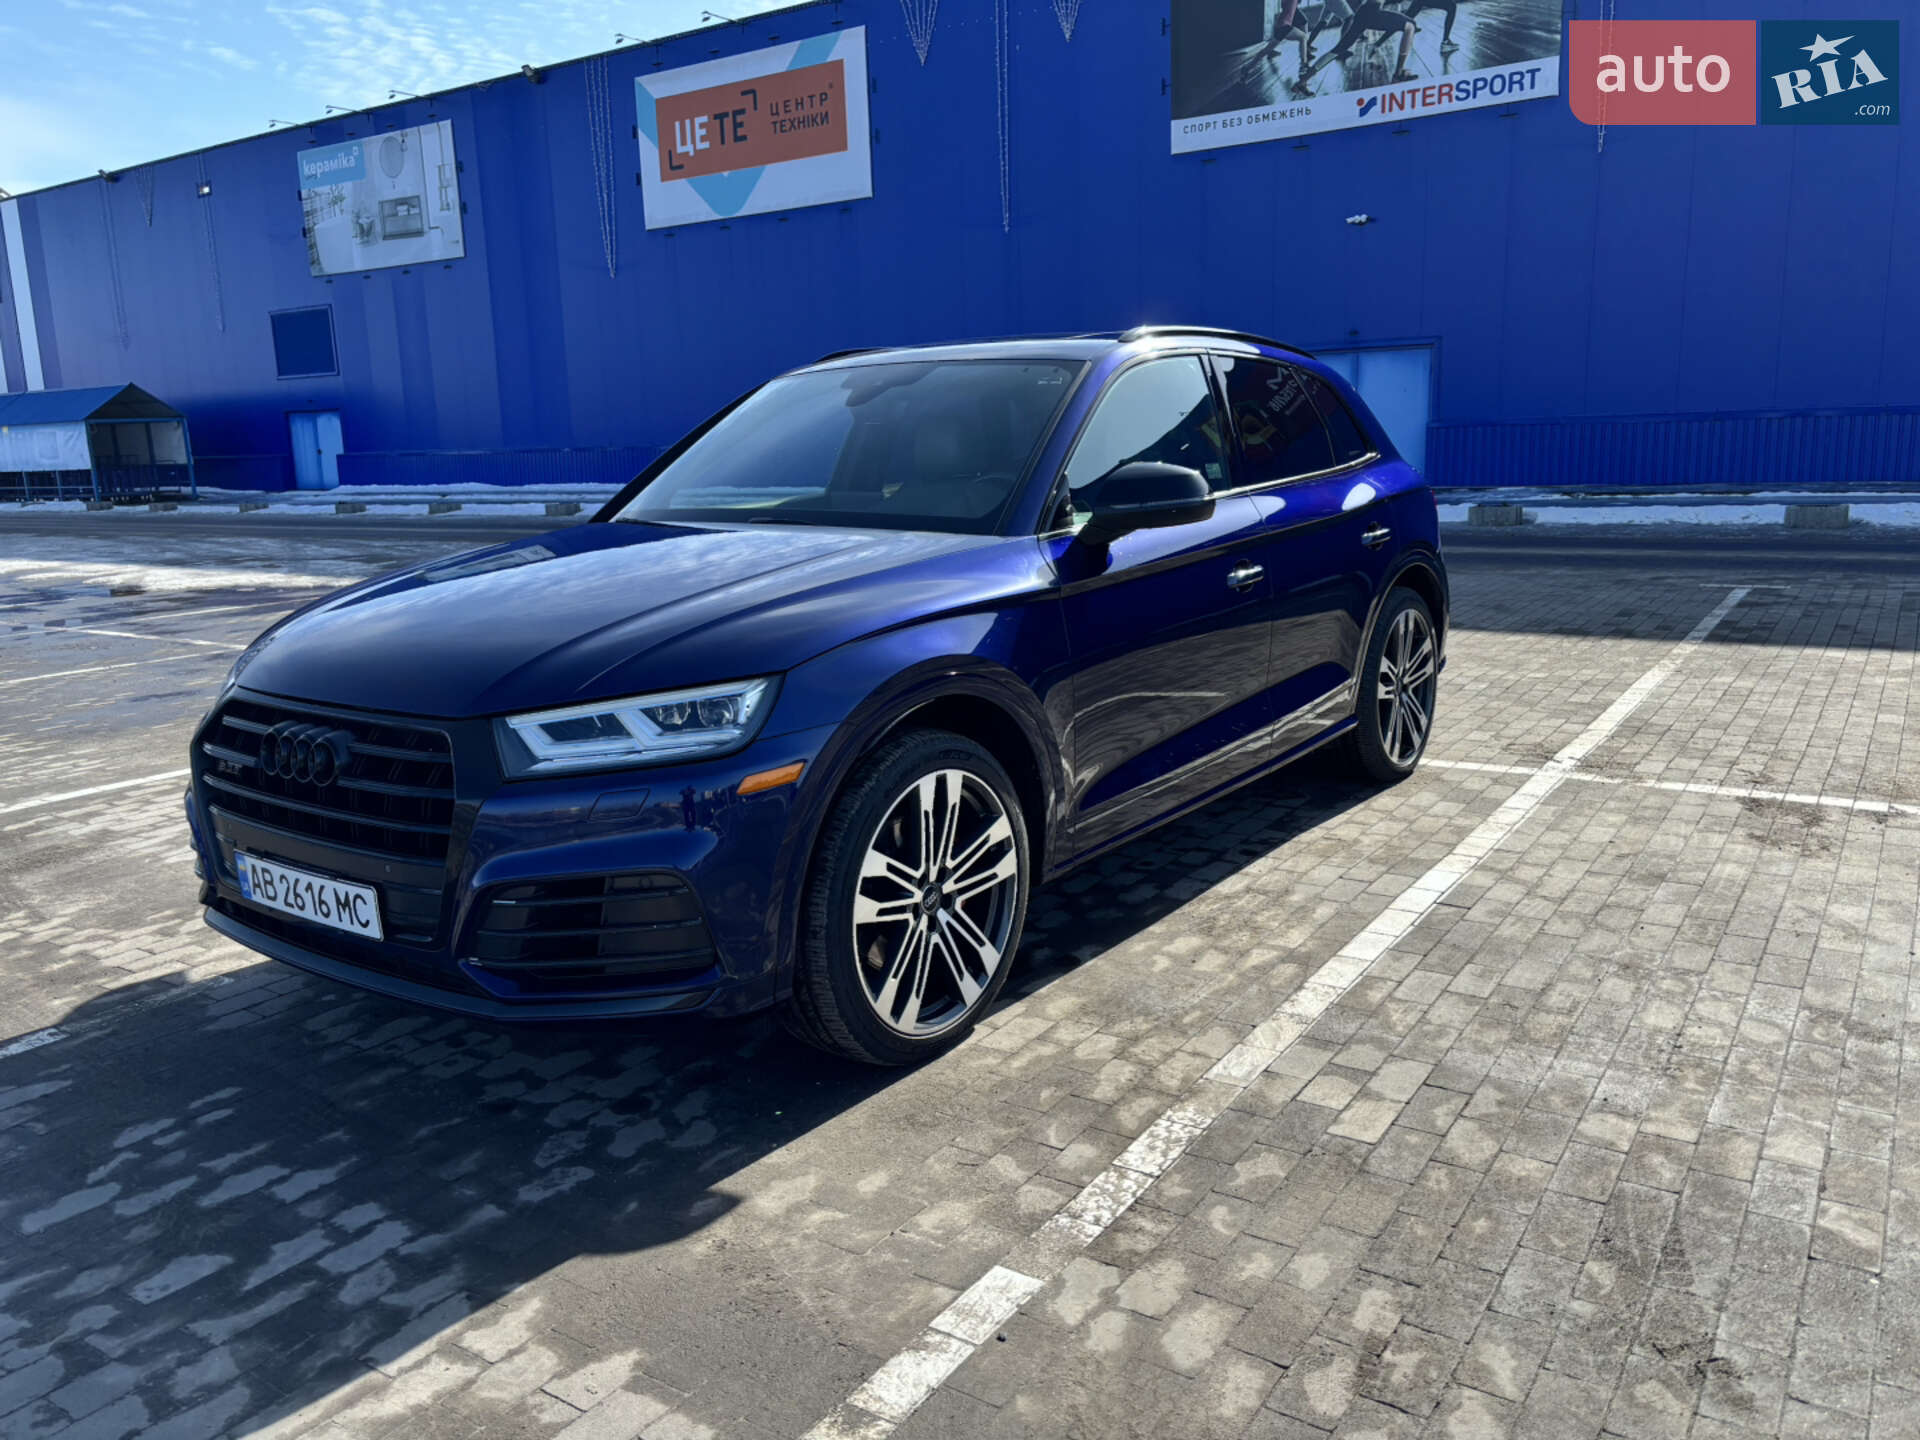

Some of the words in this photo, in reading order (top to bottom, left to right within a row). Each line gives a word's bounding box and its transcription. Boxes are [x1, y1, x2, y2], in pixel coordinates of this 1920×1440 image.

[770, 92, 829, 117] ЦЕНТР
[1381, 67, 1541, 114] INTERSPORT
[674, 108, 748, 157] ЦЕТЕ
[771, 111, 830, 135] ТЕХНІКИ
[1183, 120, 1217, 134] СПОРТ
[1222, 116, 1243, 129] БЕЗ
[1247, 106, 1312, 125] ОБМЕЖЕНЬ
[251, 863, 278, 902] AB
[279, 873, 332, 919] 2616
[333, 886, 370, 929] MC
